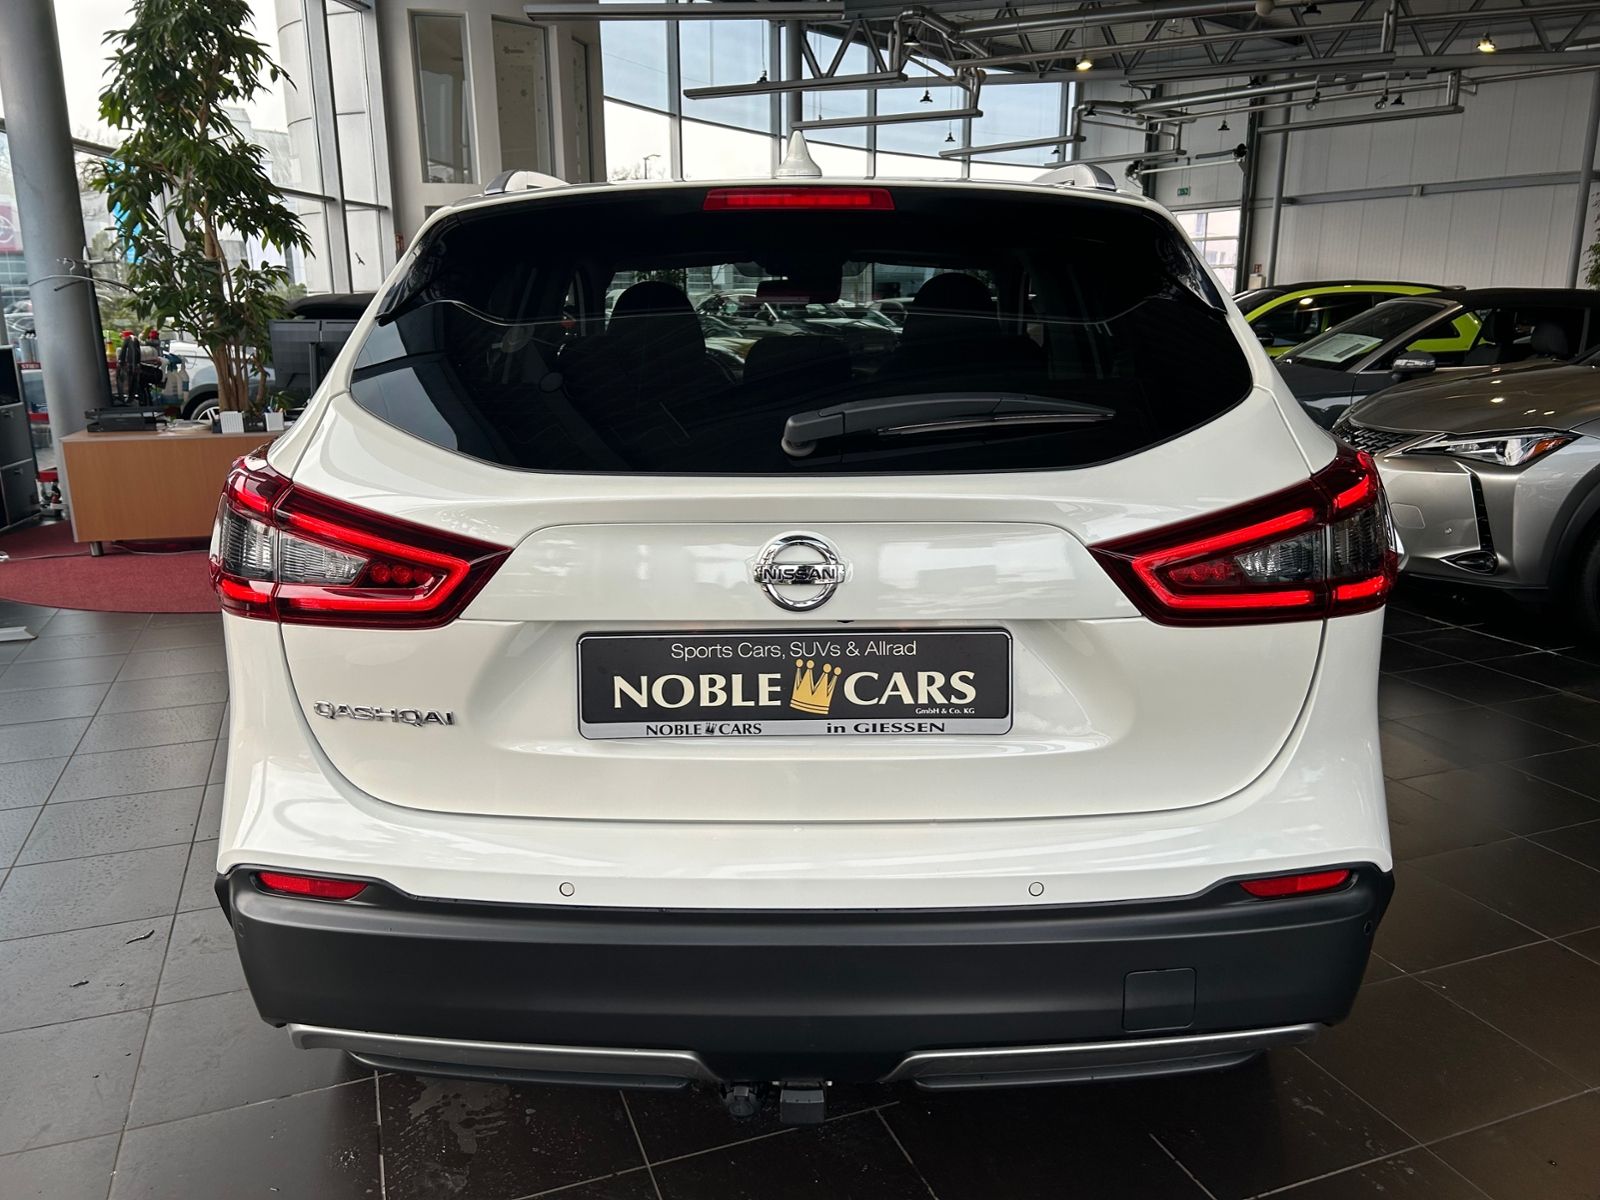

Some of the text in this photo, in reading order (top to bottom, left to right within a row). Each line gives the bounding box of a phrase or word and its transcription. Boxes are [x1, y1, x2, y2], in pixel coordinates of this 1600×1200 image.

[763, 568, 835, 580] NISSAN
[671, 640, 917, 661] Sports Cars, SUVs & Allrad
[613, 670, 977, 709] NOBLE CARS
[313, 700, 455, 727] QASHQAI
[646, 723, 762, 736] NOBLE CARS
[826, 722, 945, 733] in GIESSEN
